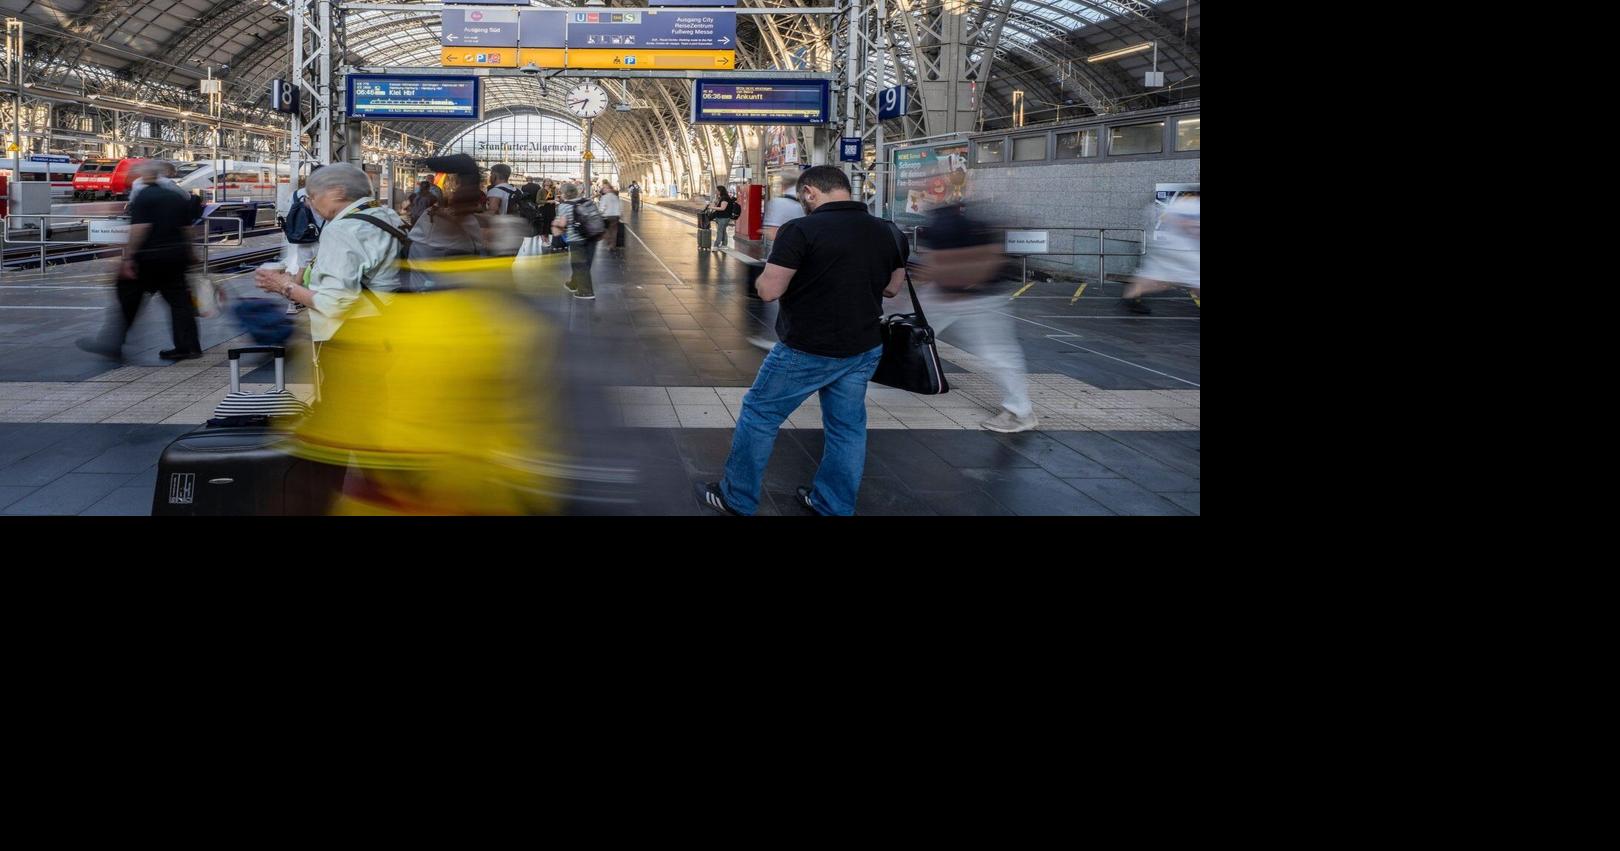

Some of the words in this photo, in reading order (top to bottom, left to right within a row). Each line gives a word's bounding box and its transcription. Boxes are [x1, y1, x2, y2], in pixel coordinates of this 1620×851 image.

[282, 82, 292, 105] 8
[886, 88, 896, 111] 9
[479, 141, 526, 152] Frankfurter
[528, 142, 577, 153] Allgemeine
